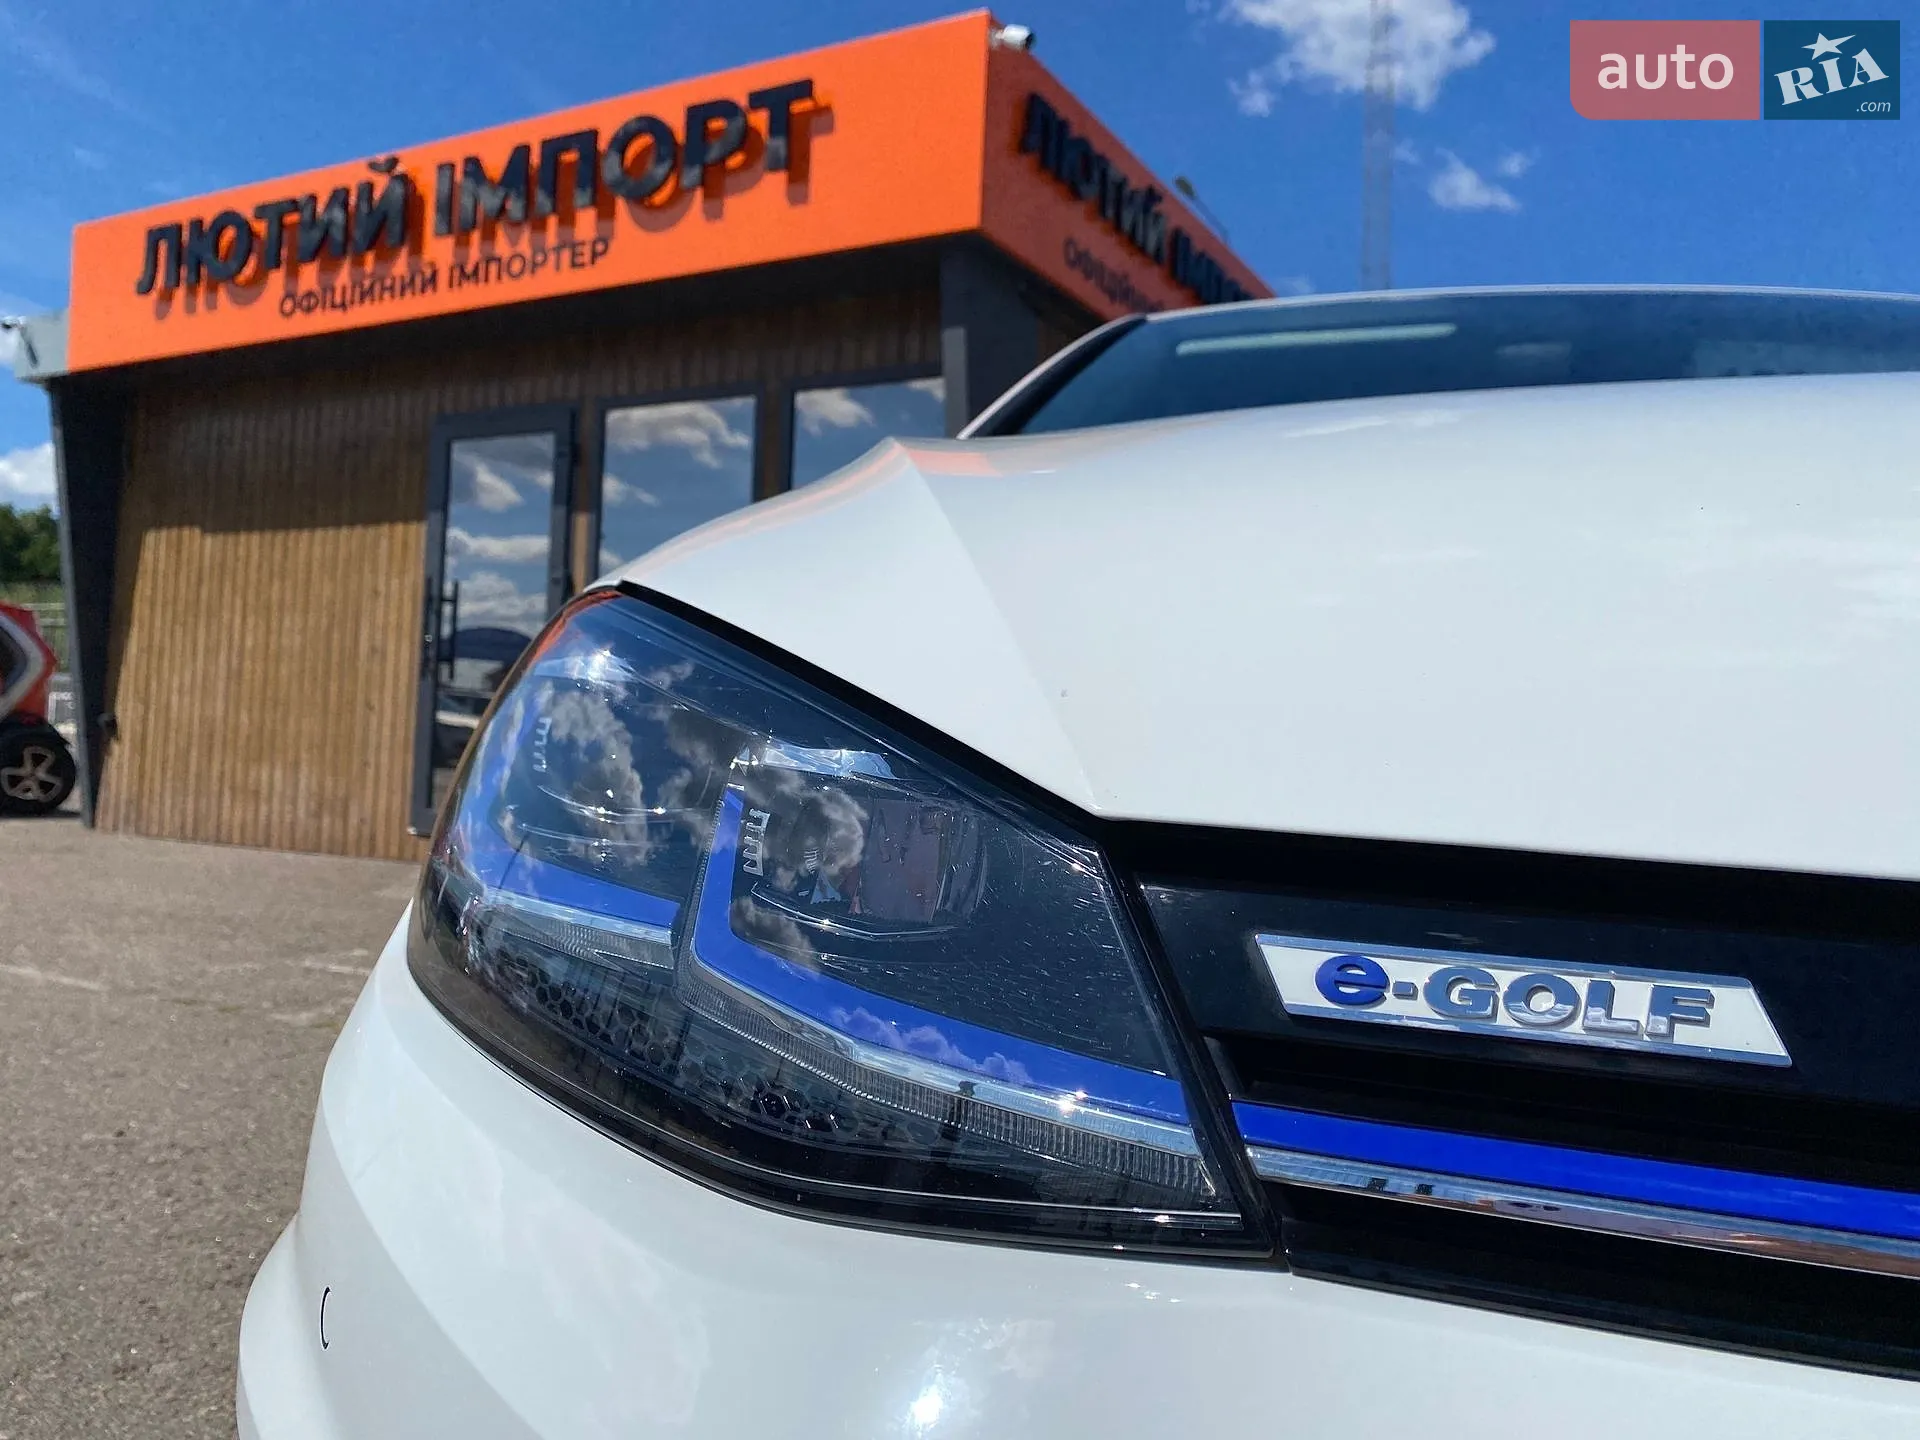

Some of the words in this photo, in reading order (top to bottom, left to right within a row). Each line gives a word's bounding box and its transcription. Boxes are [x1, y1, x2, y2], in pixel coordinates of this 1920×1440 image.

[136, 156, 409, 294] ЛЮТИЙ
[435, 78, 814, 236] ІМПОРТ
[279, 260, 438, 317] ОФІЦІЙНИЙ
[448, 238, 610, 289] ІМПОРТЕР
[1314, 955, 1715, 1042] e-GOLF
